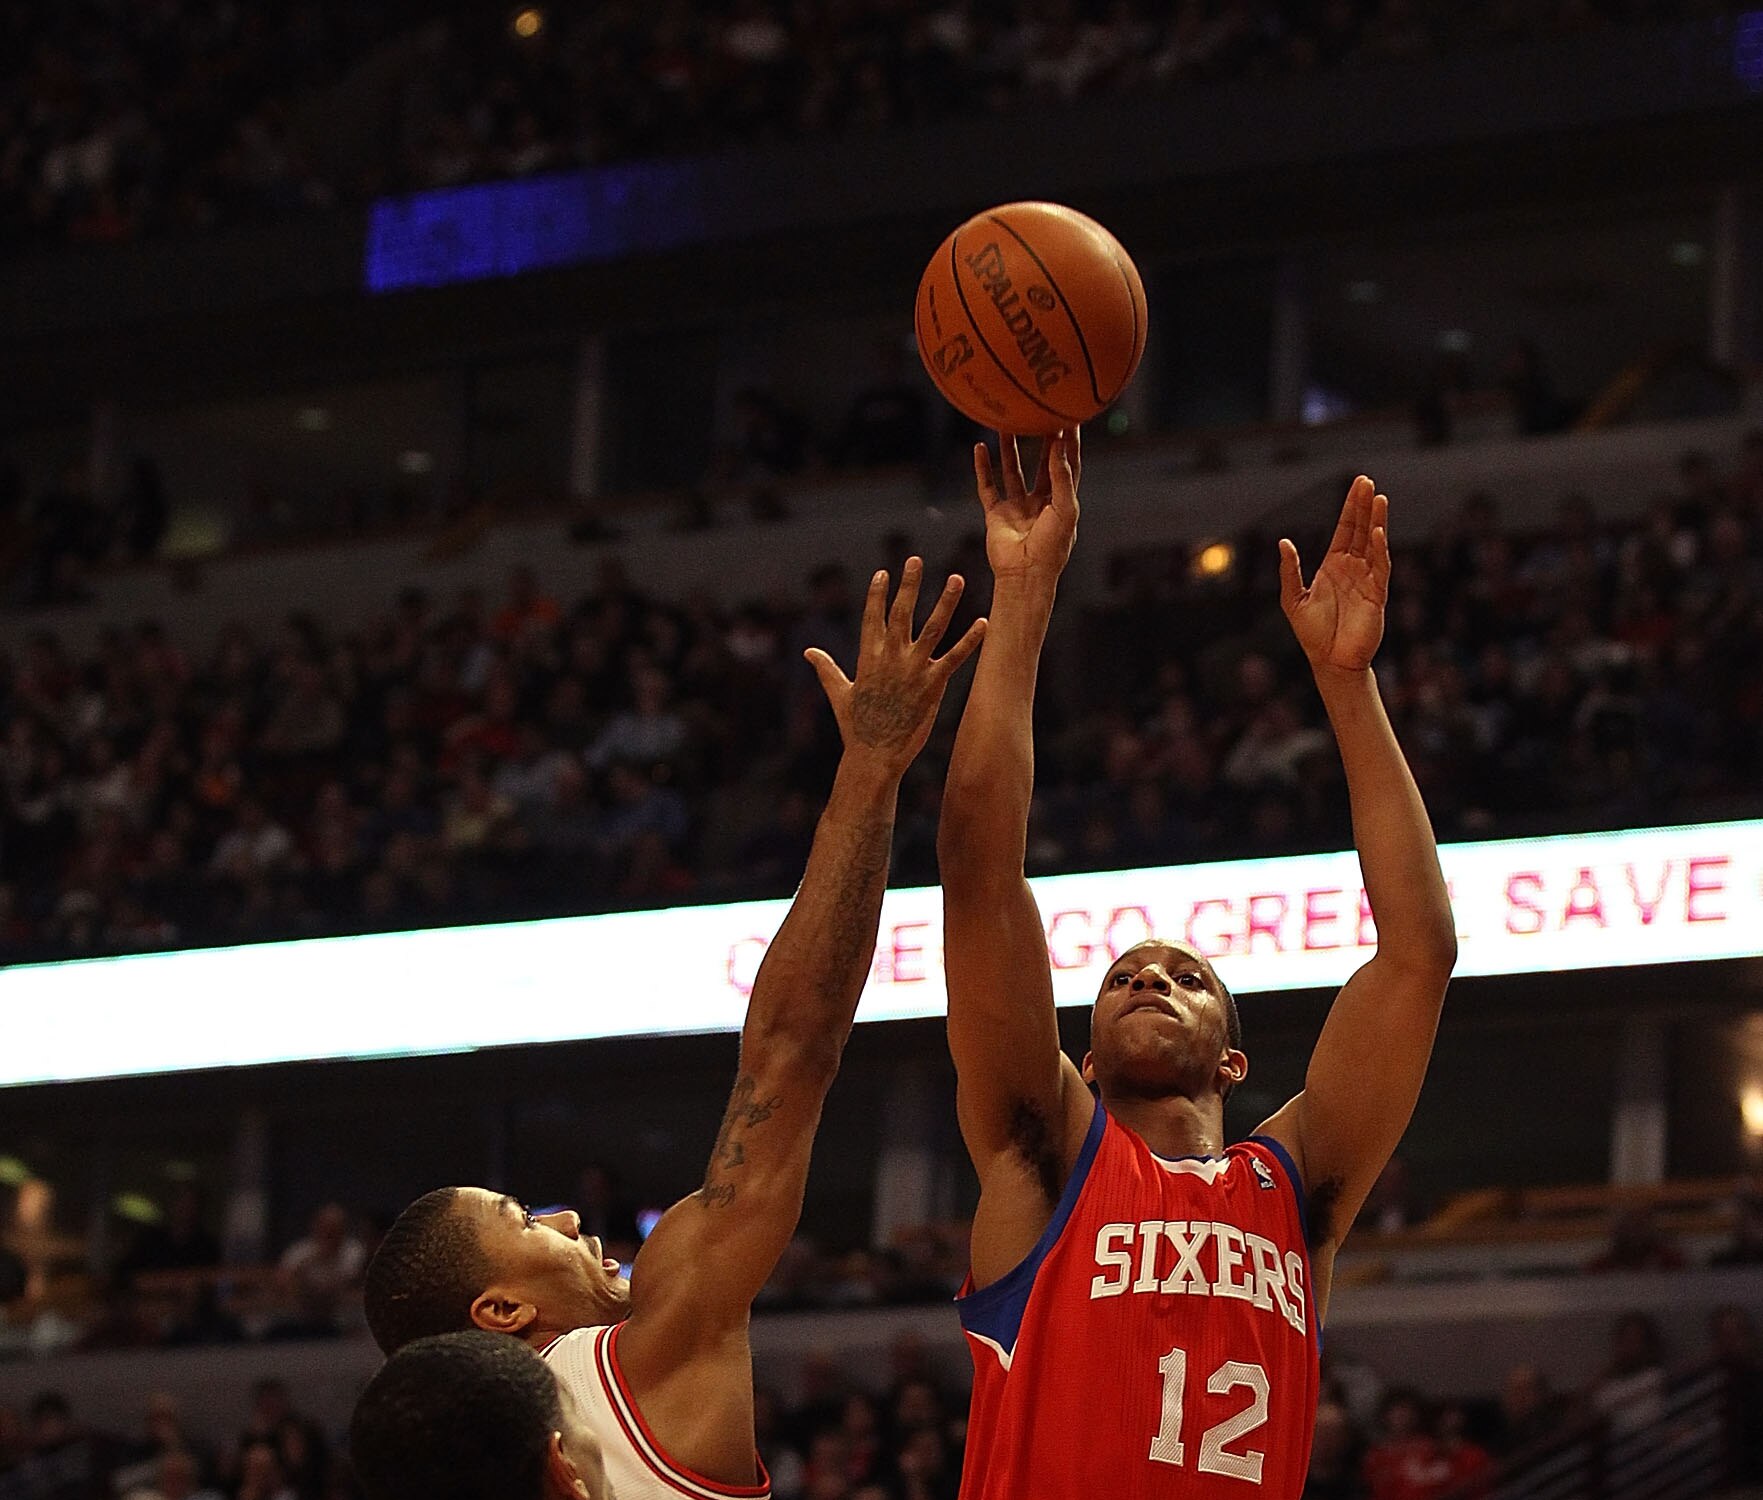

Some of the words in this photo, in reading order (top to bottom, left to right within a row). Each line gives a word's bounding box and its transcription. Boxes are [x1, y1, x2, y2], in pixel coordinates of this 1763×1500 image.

[1050, 905, 1153, 970] GO
[1505, 855, 1730, 935] SAVE
[1090, 1221, 1306, 1336] SIXERS
[1149, 1348, 1270, 1485] 12
